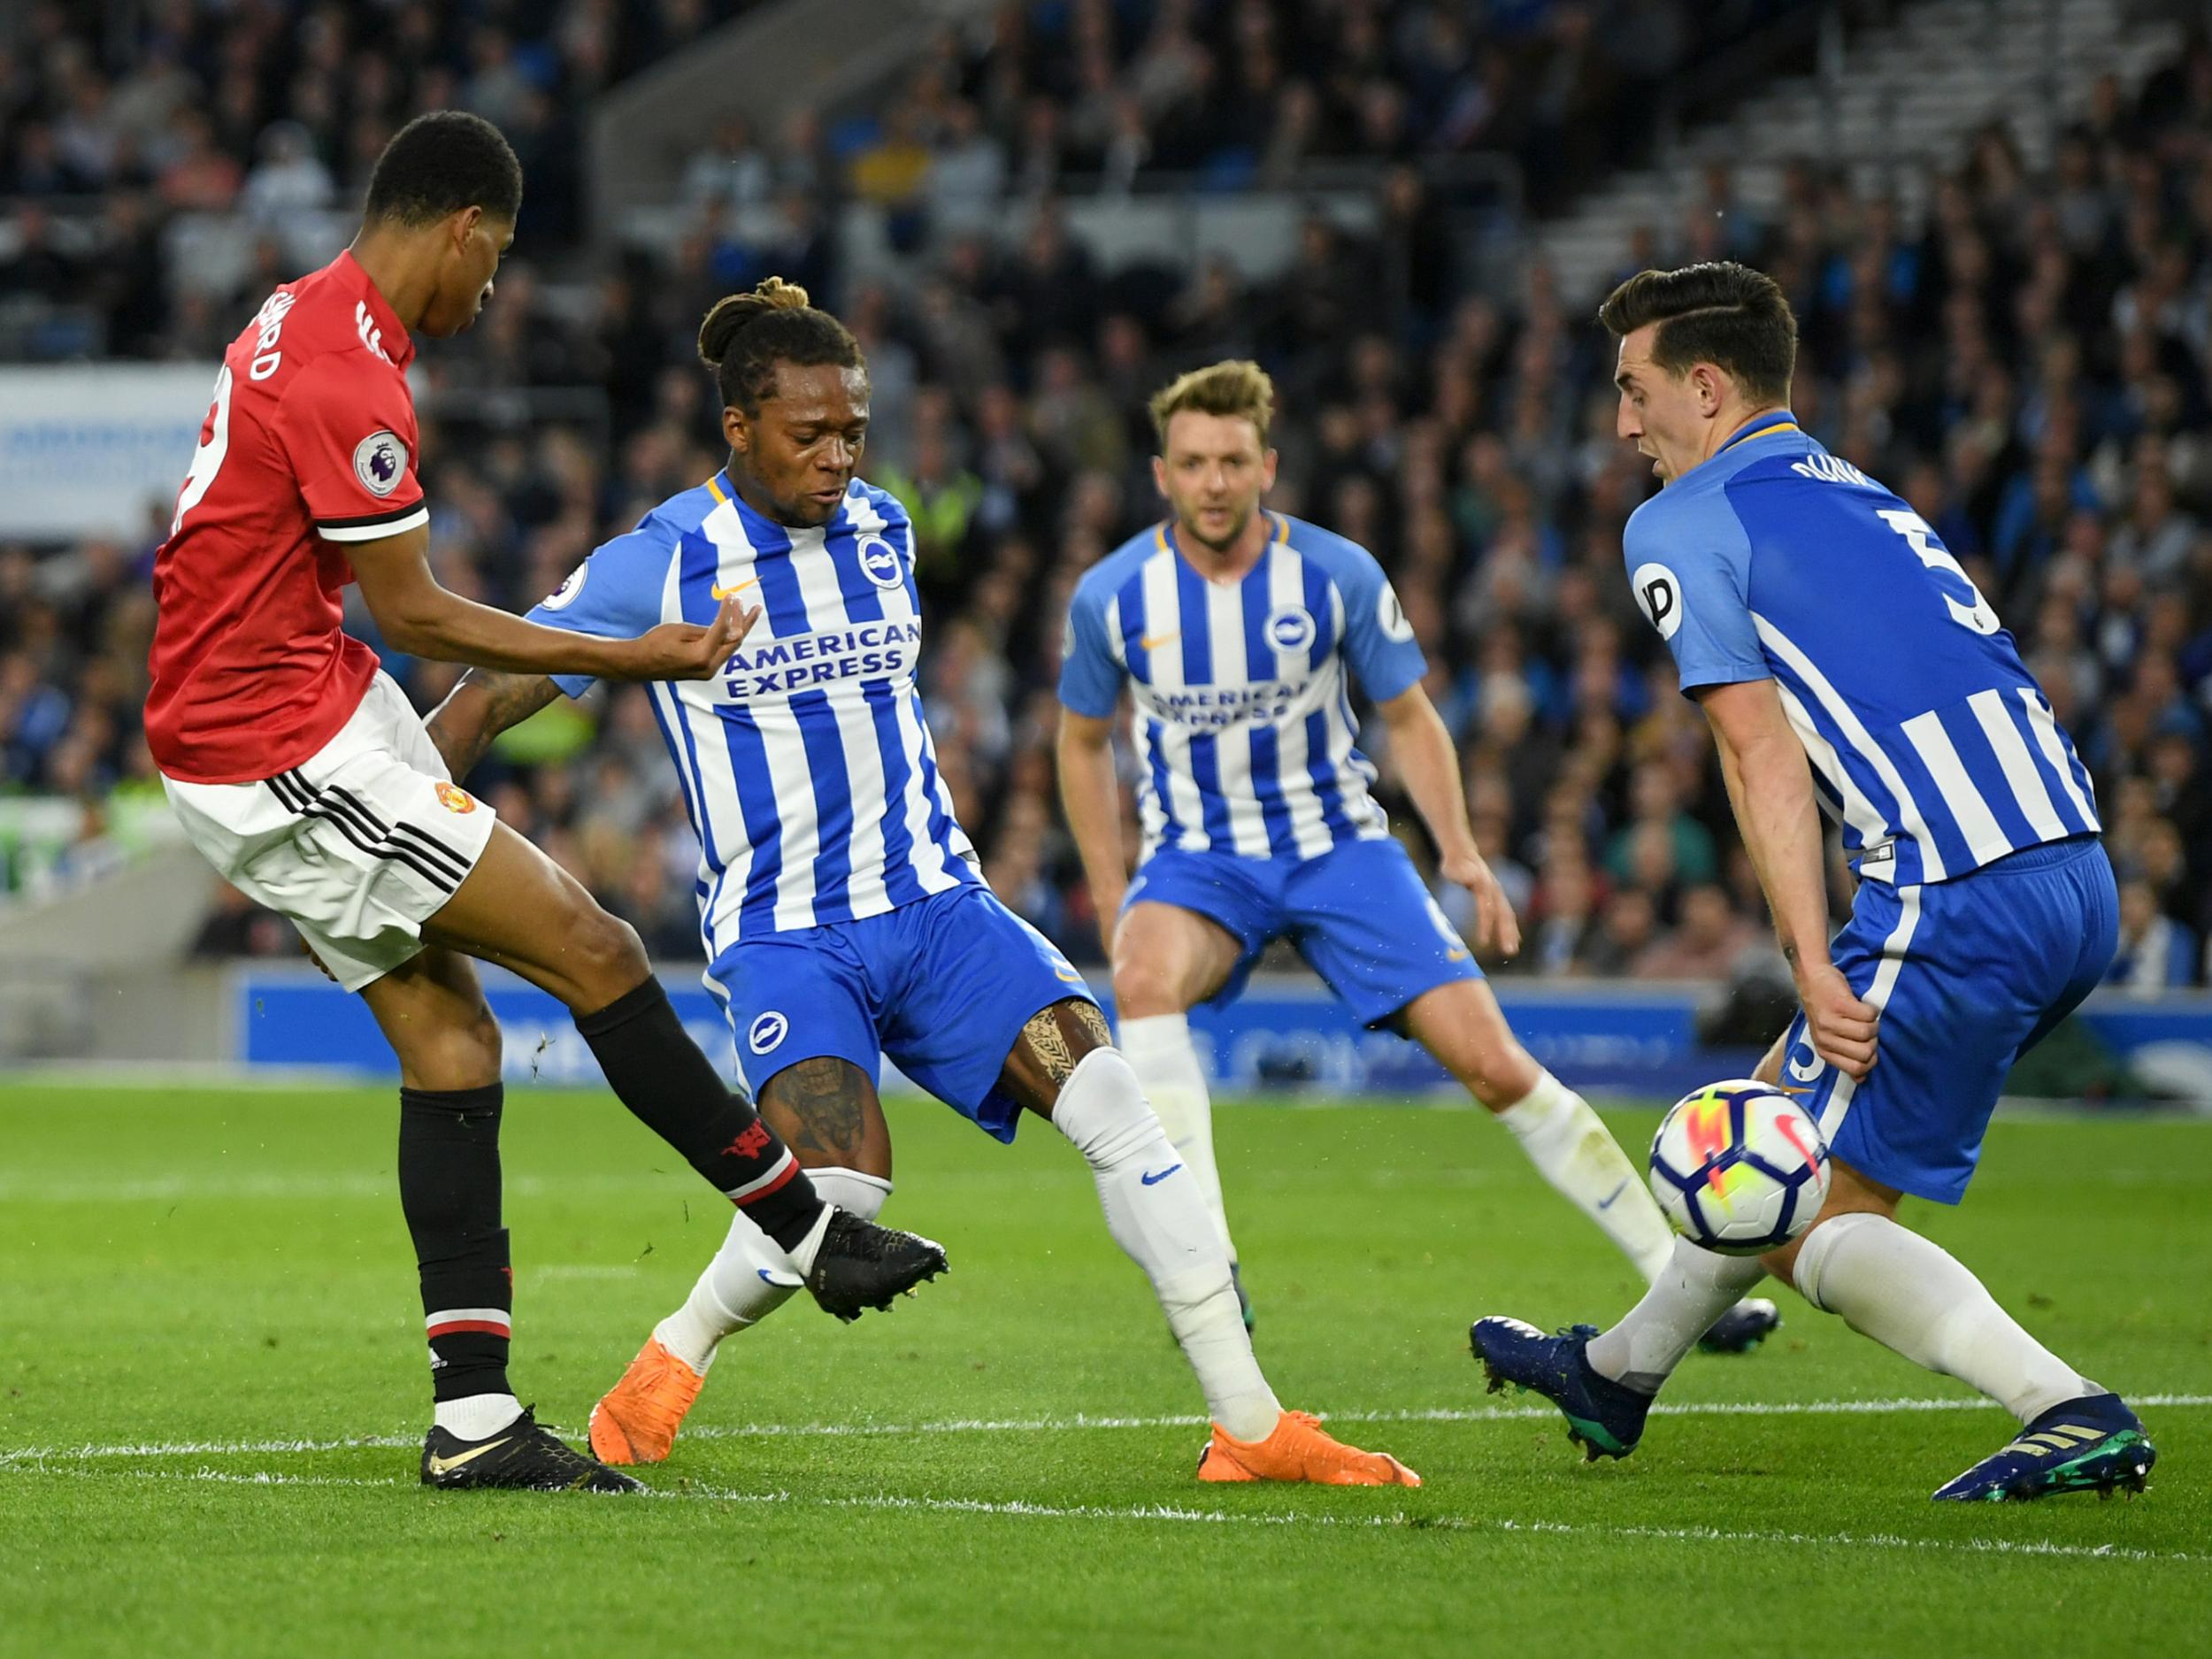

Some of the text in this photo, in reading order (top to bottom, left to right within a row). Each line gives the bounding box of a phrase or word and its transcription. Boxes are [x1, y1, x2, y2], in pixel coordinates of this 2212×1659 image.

[171, 363, 234, 537] 9
[1877, 509, 2001, 636] 5
[723, 623, 922, 675] AMERICAN
[726, 650, 902, 698] EXPRESS
